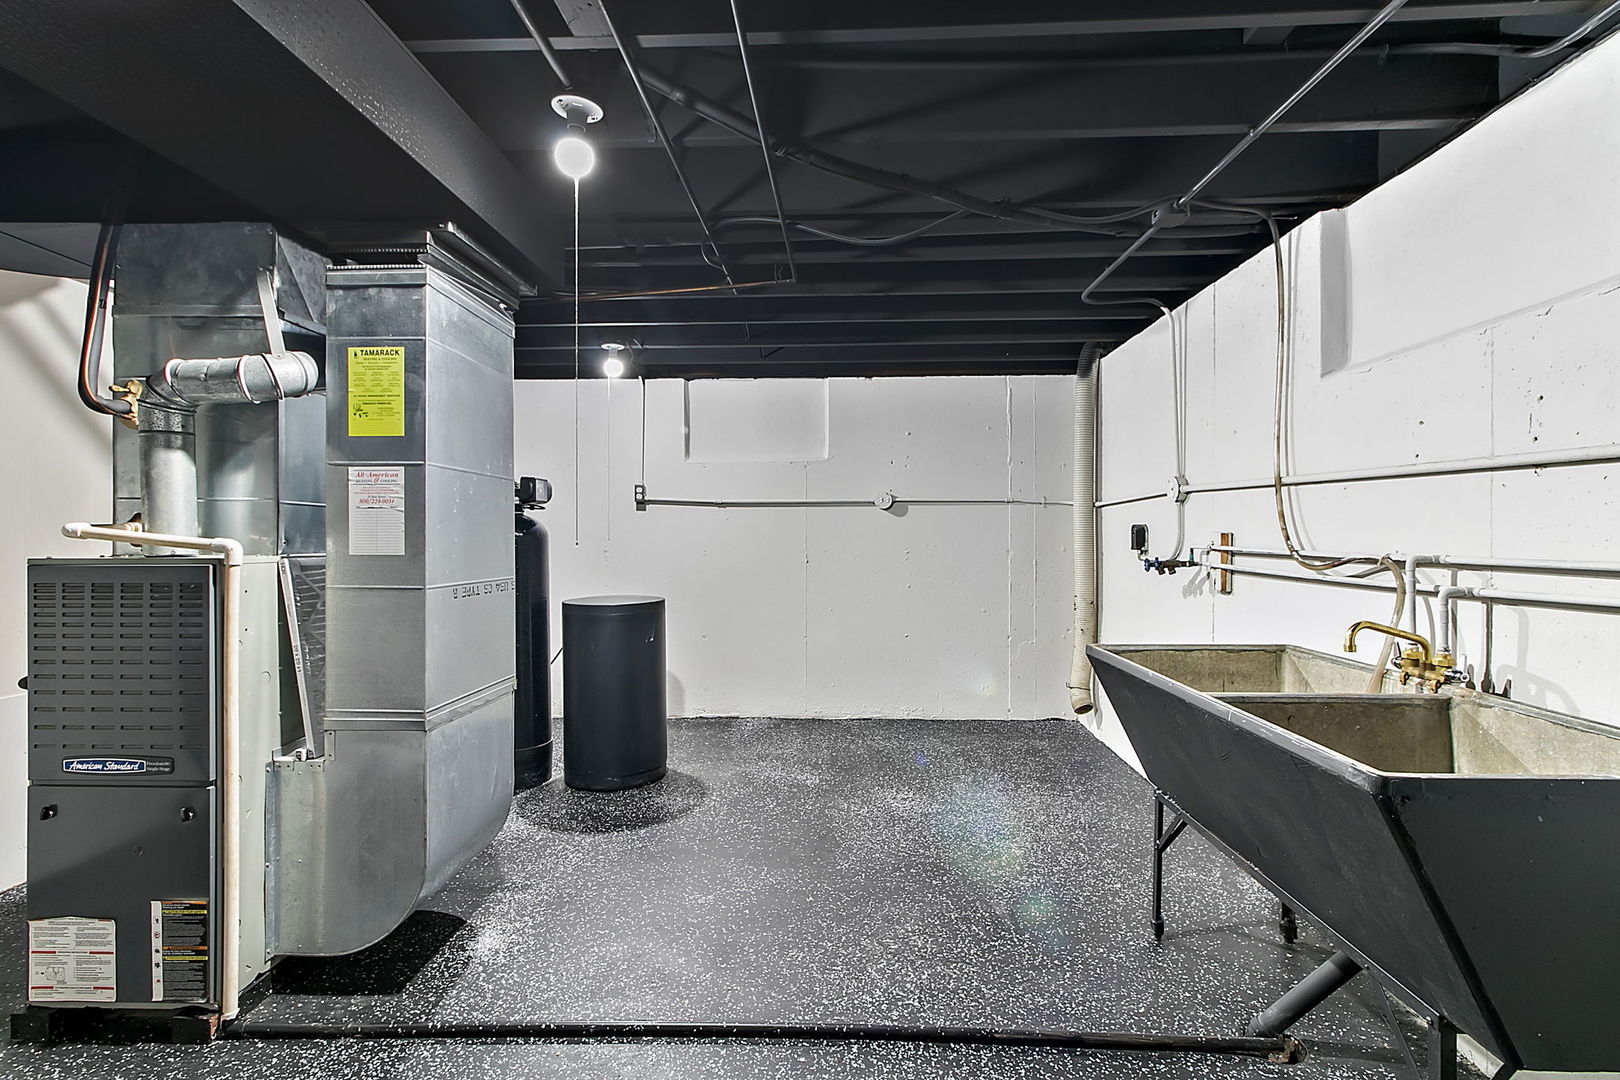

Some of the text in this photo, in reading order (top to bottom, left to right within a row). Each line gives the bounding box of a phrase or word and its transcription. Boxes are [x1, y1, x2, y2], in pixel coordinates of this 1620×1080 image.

[461, 585, 480, 598] TYPE
[495, 581, 509, 592] USA
[69, 761, 140, 770] American Standard
